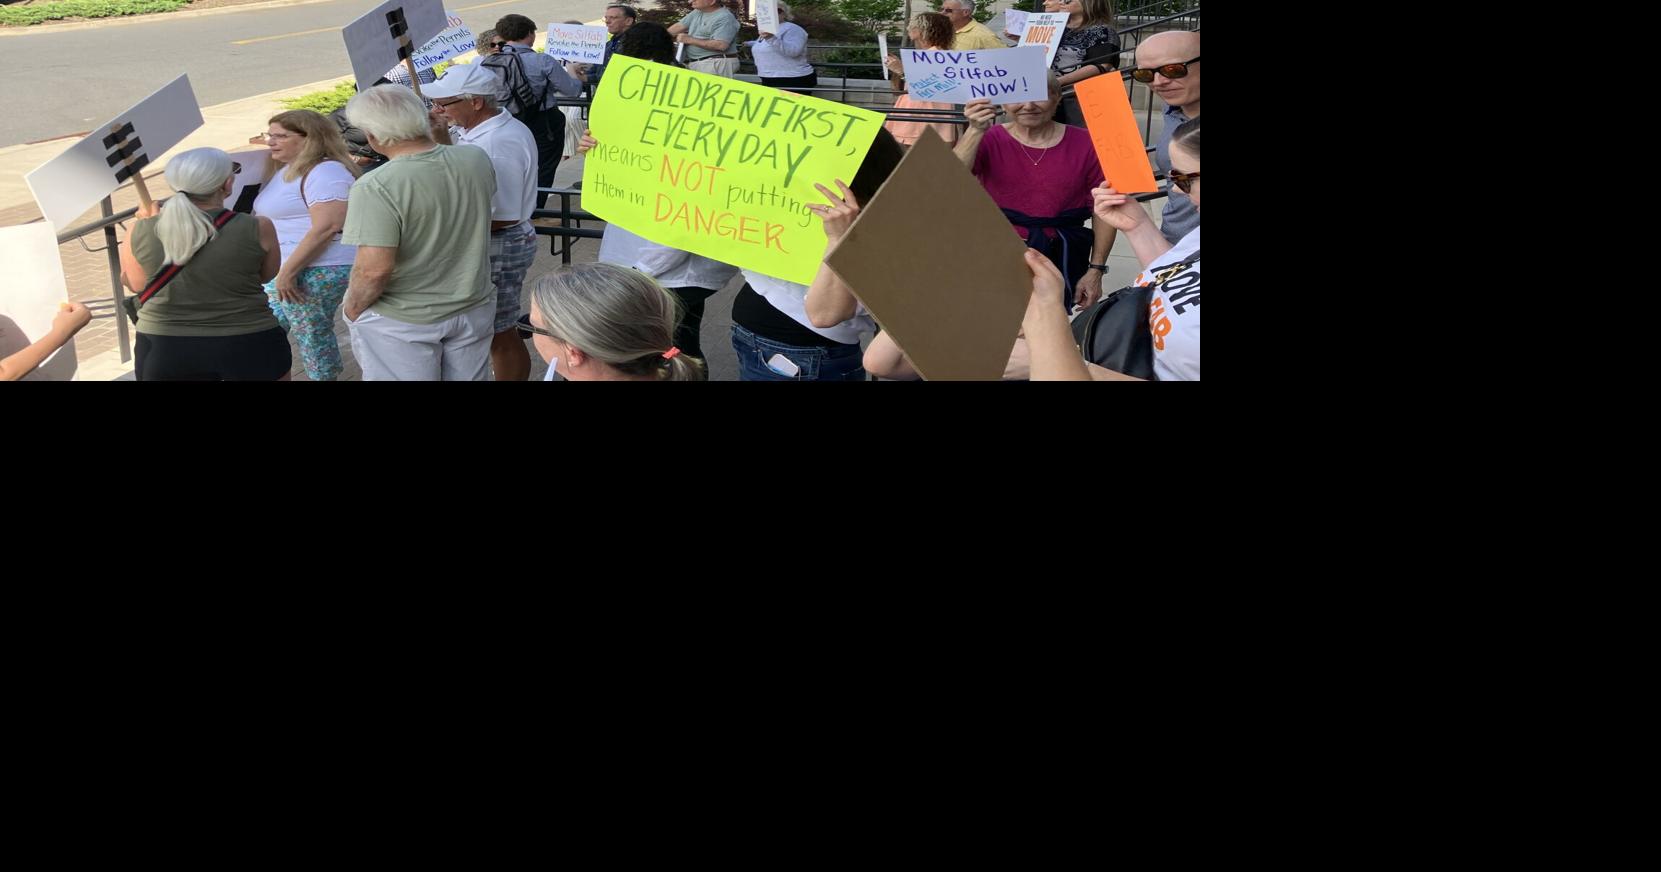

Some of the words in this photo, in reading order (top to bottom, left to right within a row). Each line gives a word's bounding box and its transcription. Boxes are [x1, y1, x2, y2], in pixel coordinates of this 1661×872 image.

[1025, 25, 1056, 44] MOVE
[413, 51, 444, 68] Follow
[549, 47, 570, 57] Follow
[912, 51, 978, 64] MOVE
[943, 65, 1008, 79] Silfab
[618, 64, 764, 124] CHILDREN
[971, 77, 1029, 98] NOW!
[592, 143, 653, 172] means
[660, 154, 726, 195] NOT
[727, 183, 813, 228] putting
[594, 172, 624, 199] them
[629, 188, 645, 206] in
[654, 192, 790, 254] DANGER
